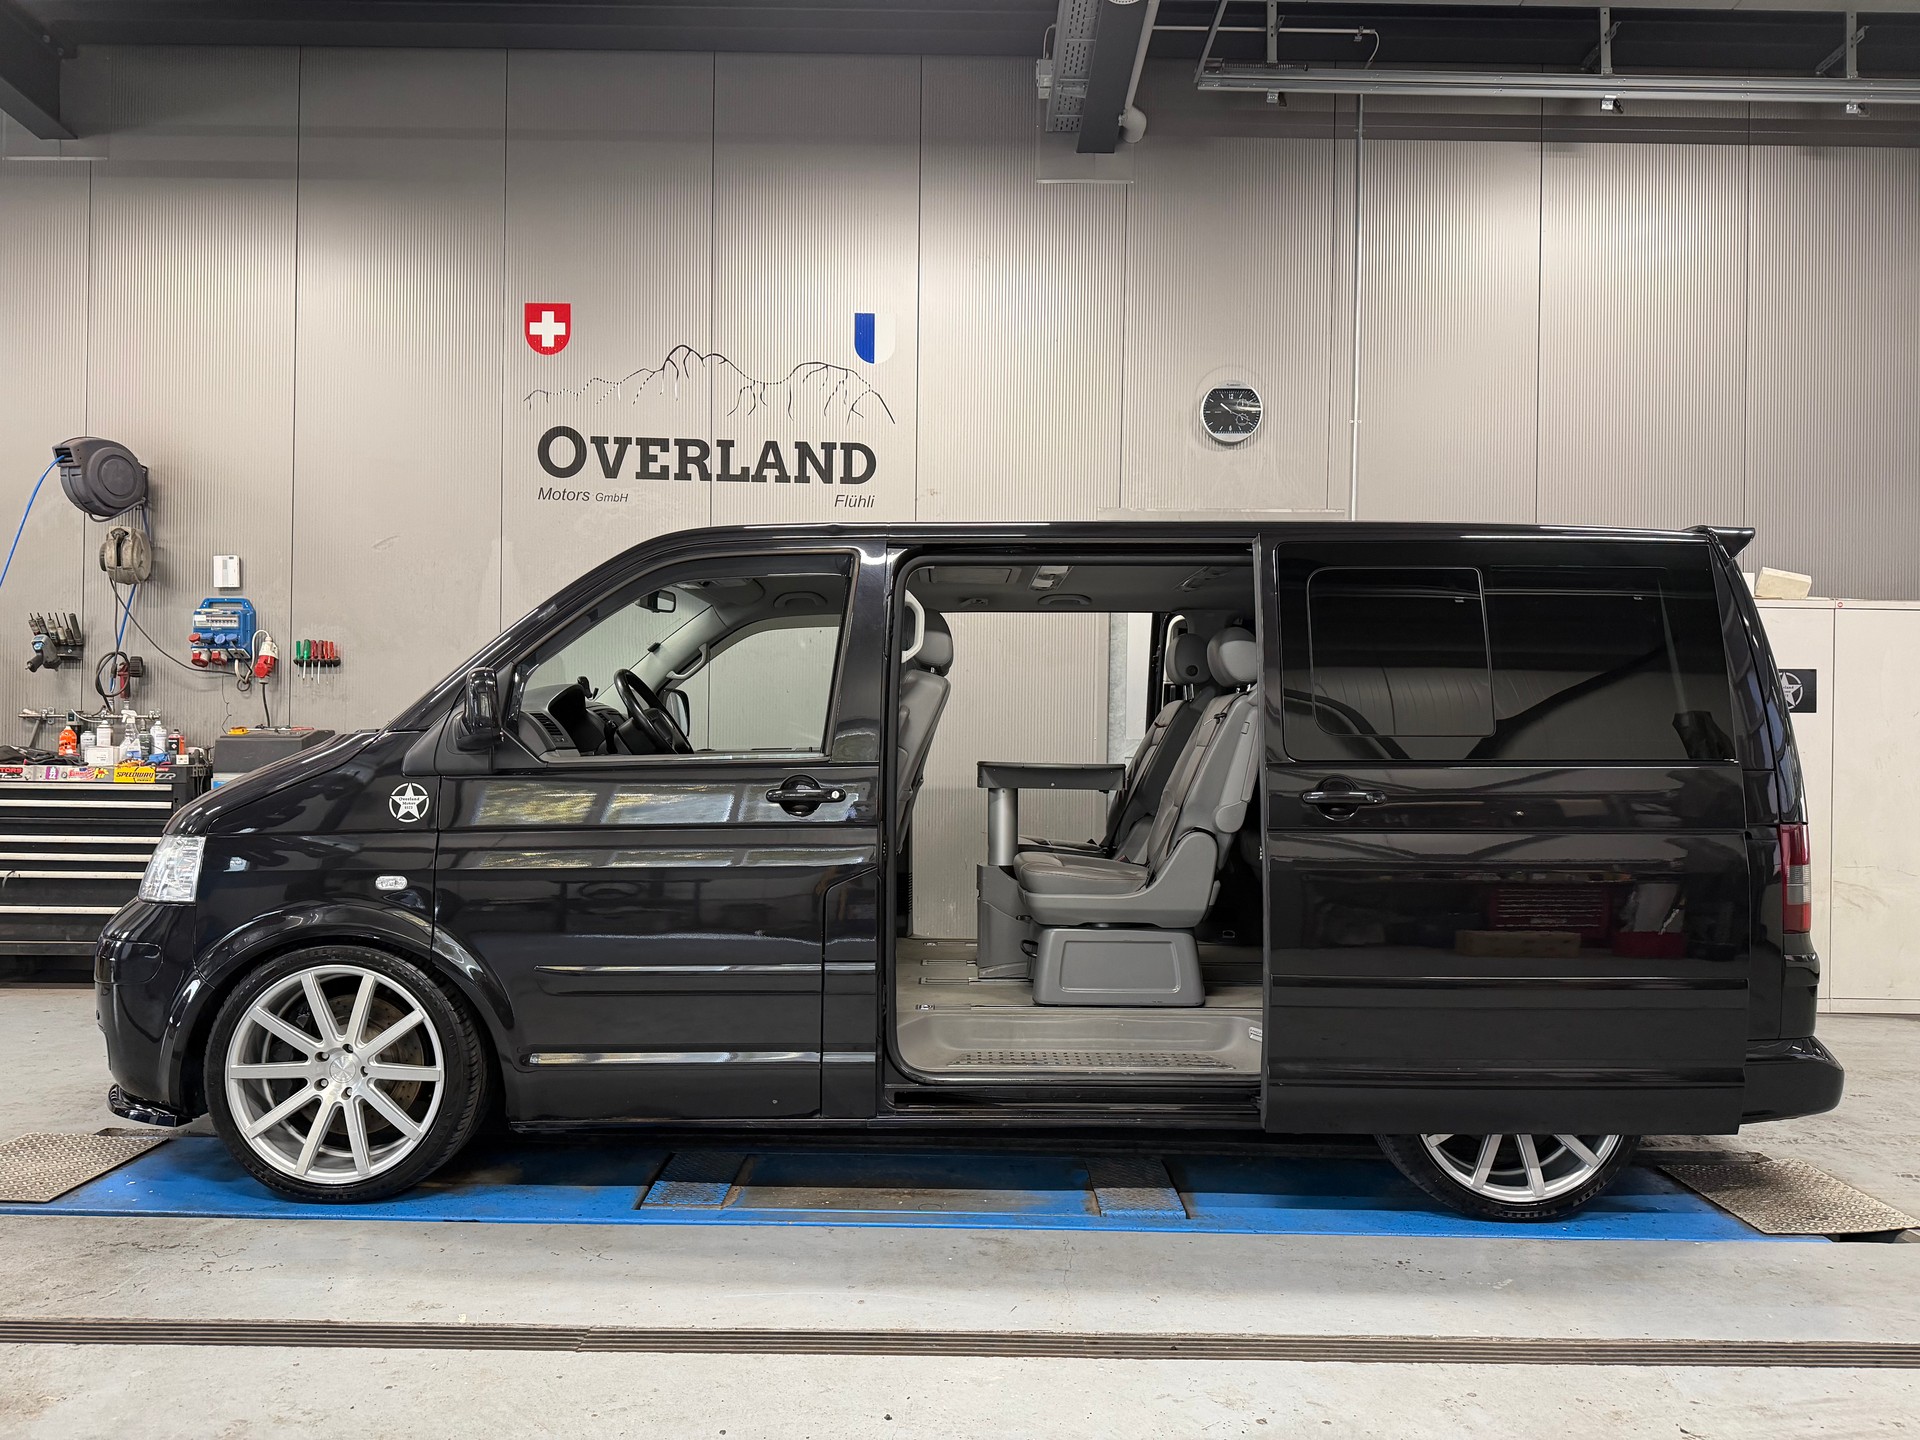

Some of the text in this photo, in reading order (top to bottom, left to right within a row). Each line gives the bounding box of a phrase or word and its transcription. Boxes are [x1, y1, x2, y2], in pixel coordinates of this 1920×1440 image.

[537, 425, 877, 485] OVERLAND
[537, 487, 629, 503] Motors GmbH
[834, 494, 875, 508] Flühli
